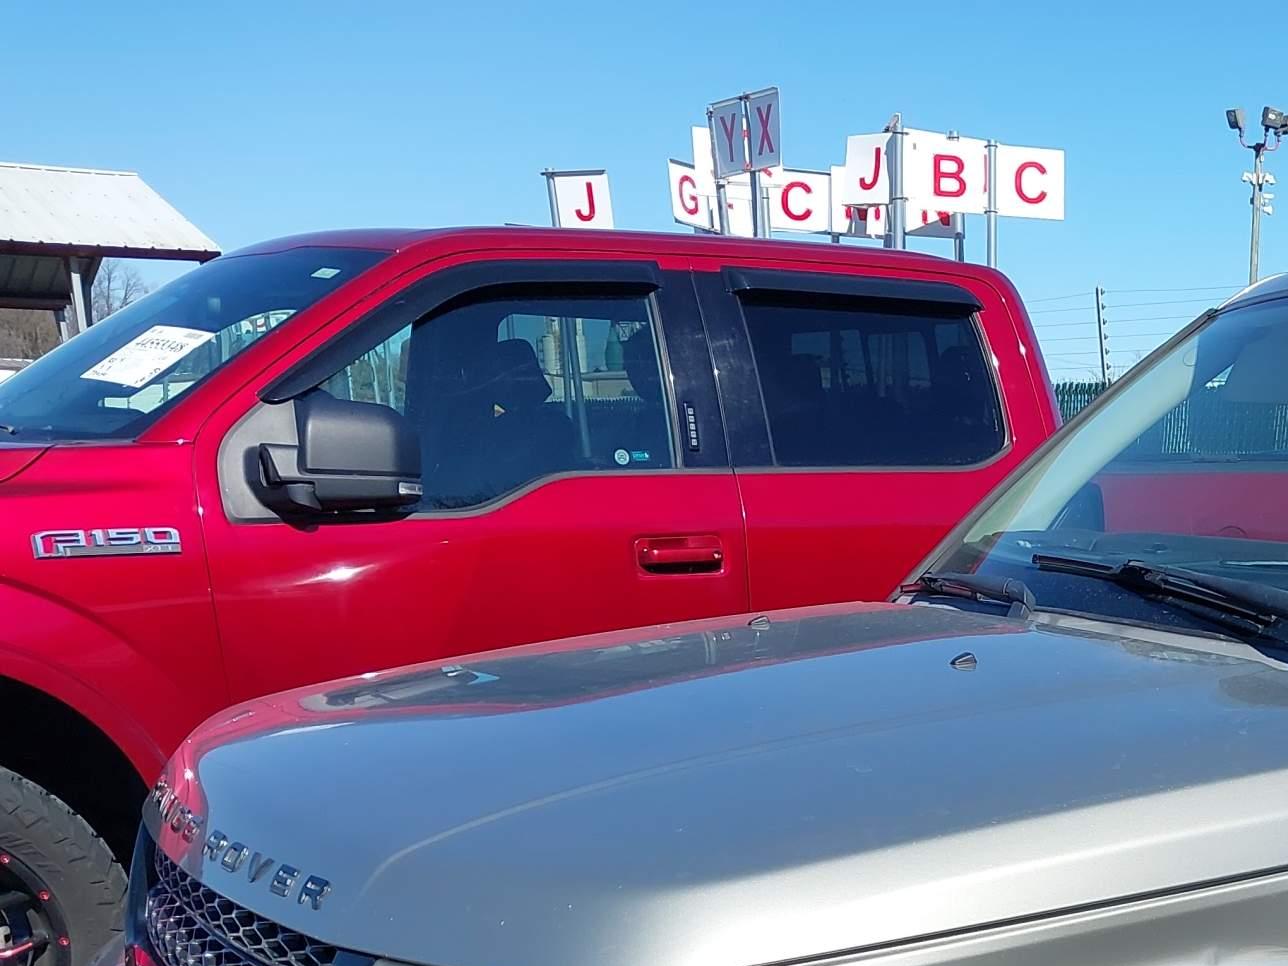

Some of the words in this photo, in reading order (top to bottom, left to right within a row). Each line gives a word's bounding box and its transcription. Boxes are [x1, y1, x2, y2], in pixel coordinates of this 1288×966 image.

[720, 113, 736, 163] Y
[756, 103, 774, 156] X
[859, 146, 881, 190] J
[933, 154, 967, 197] B
[1014, 161, 1048, 204] C
[575, 181, 595, 222] J
[679, 175, 699, 215] G
[781, 181, 812, 221] C
[202, 829, 333, 911] ROVER
